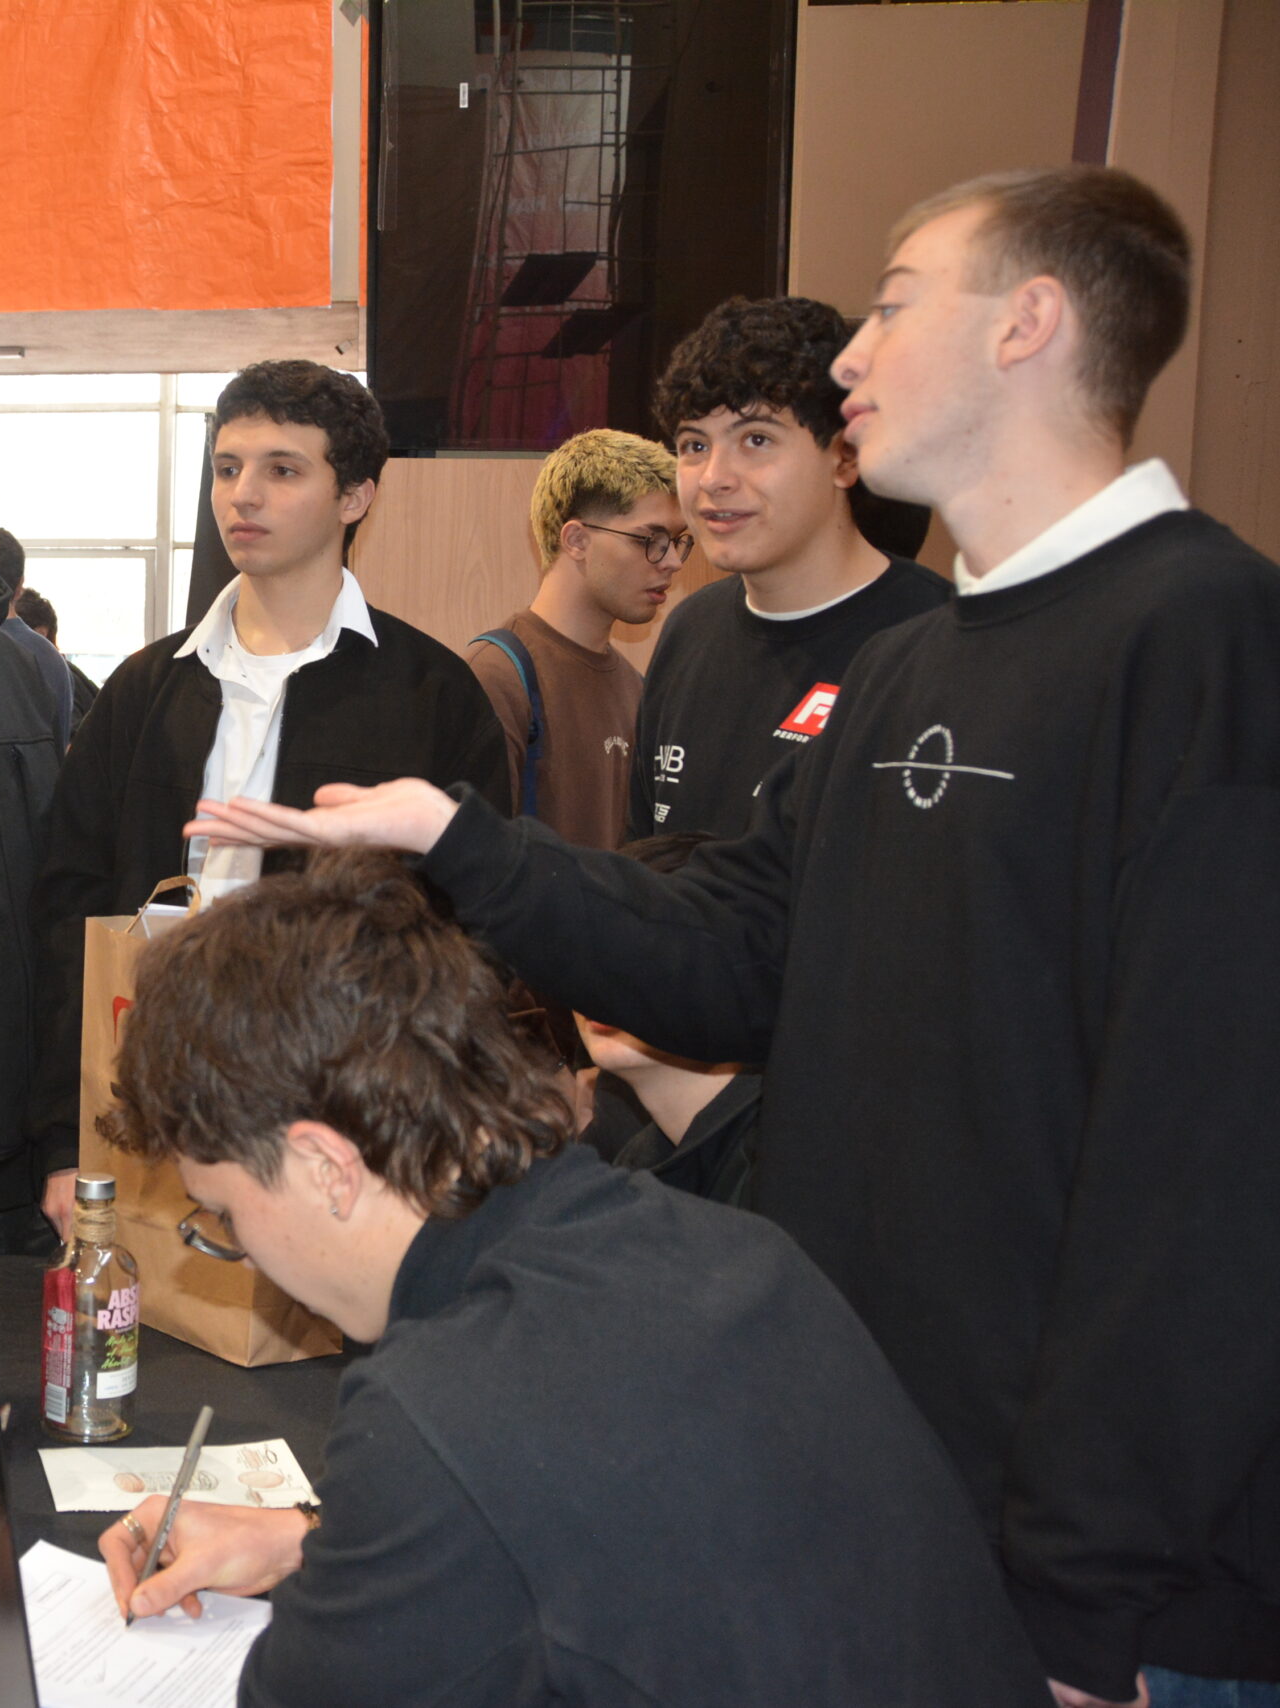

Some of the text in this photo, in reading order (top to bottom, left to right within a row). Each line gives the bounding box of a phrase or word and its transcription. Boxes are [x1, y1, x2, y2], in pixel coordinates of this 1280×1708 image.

[772, 729, 812, 743] PERFOR
[107, 1285, 139, 1310] ABS
[97, 1305, 139, 1330] RASP
